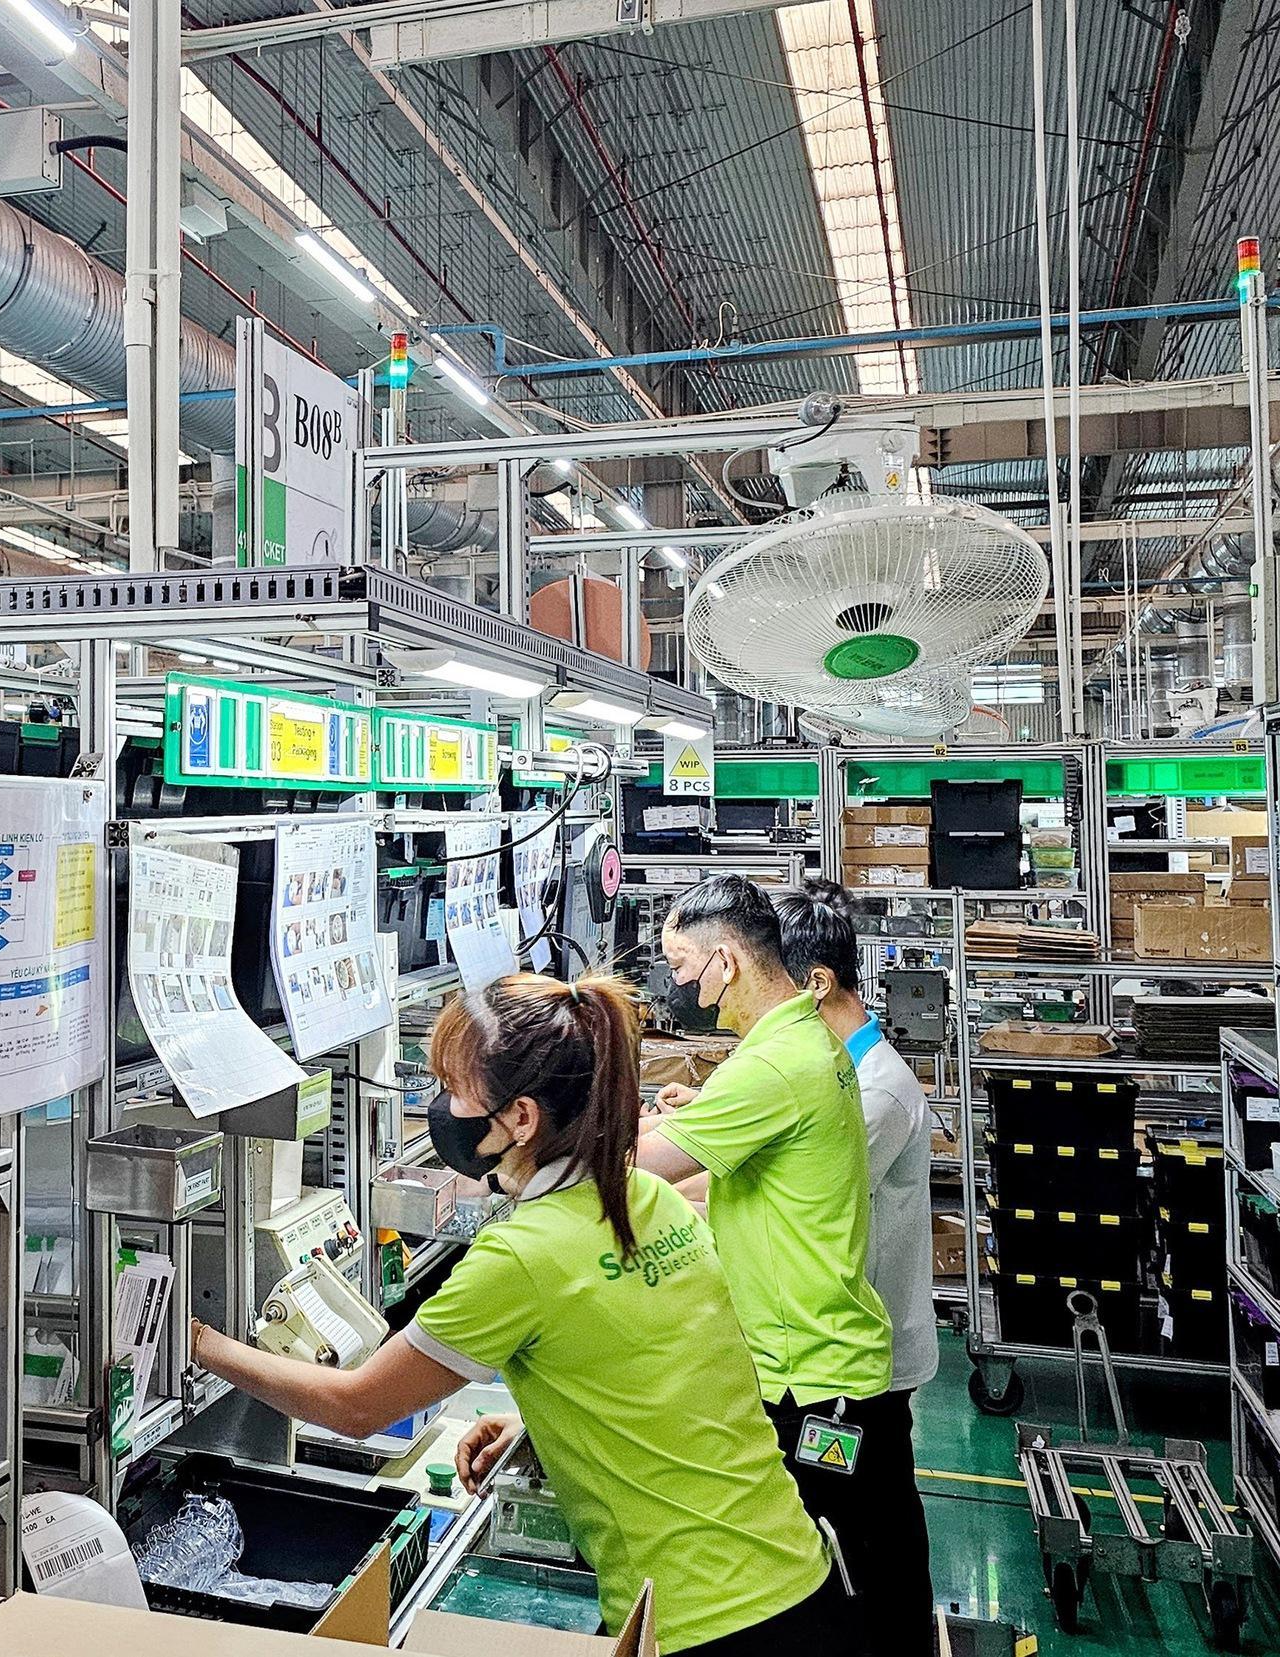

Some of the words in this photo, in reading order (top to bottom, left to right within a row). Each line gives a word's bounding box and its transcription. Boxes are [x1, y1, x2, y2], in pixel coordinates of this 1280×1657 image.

[680, 760, 700, 768] WIP
[669, 779, 678, 791] 8
[684, 781, 710, 791] PCS
[1, 833, 19, 842] LINH
[45, 1515, 56, 1524] EA
